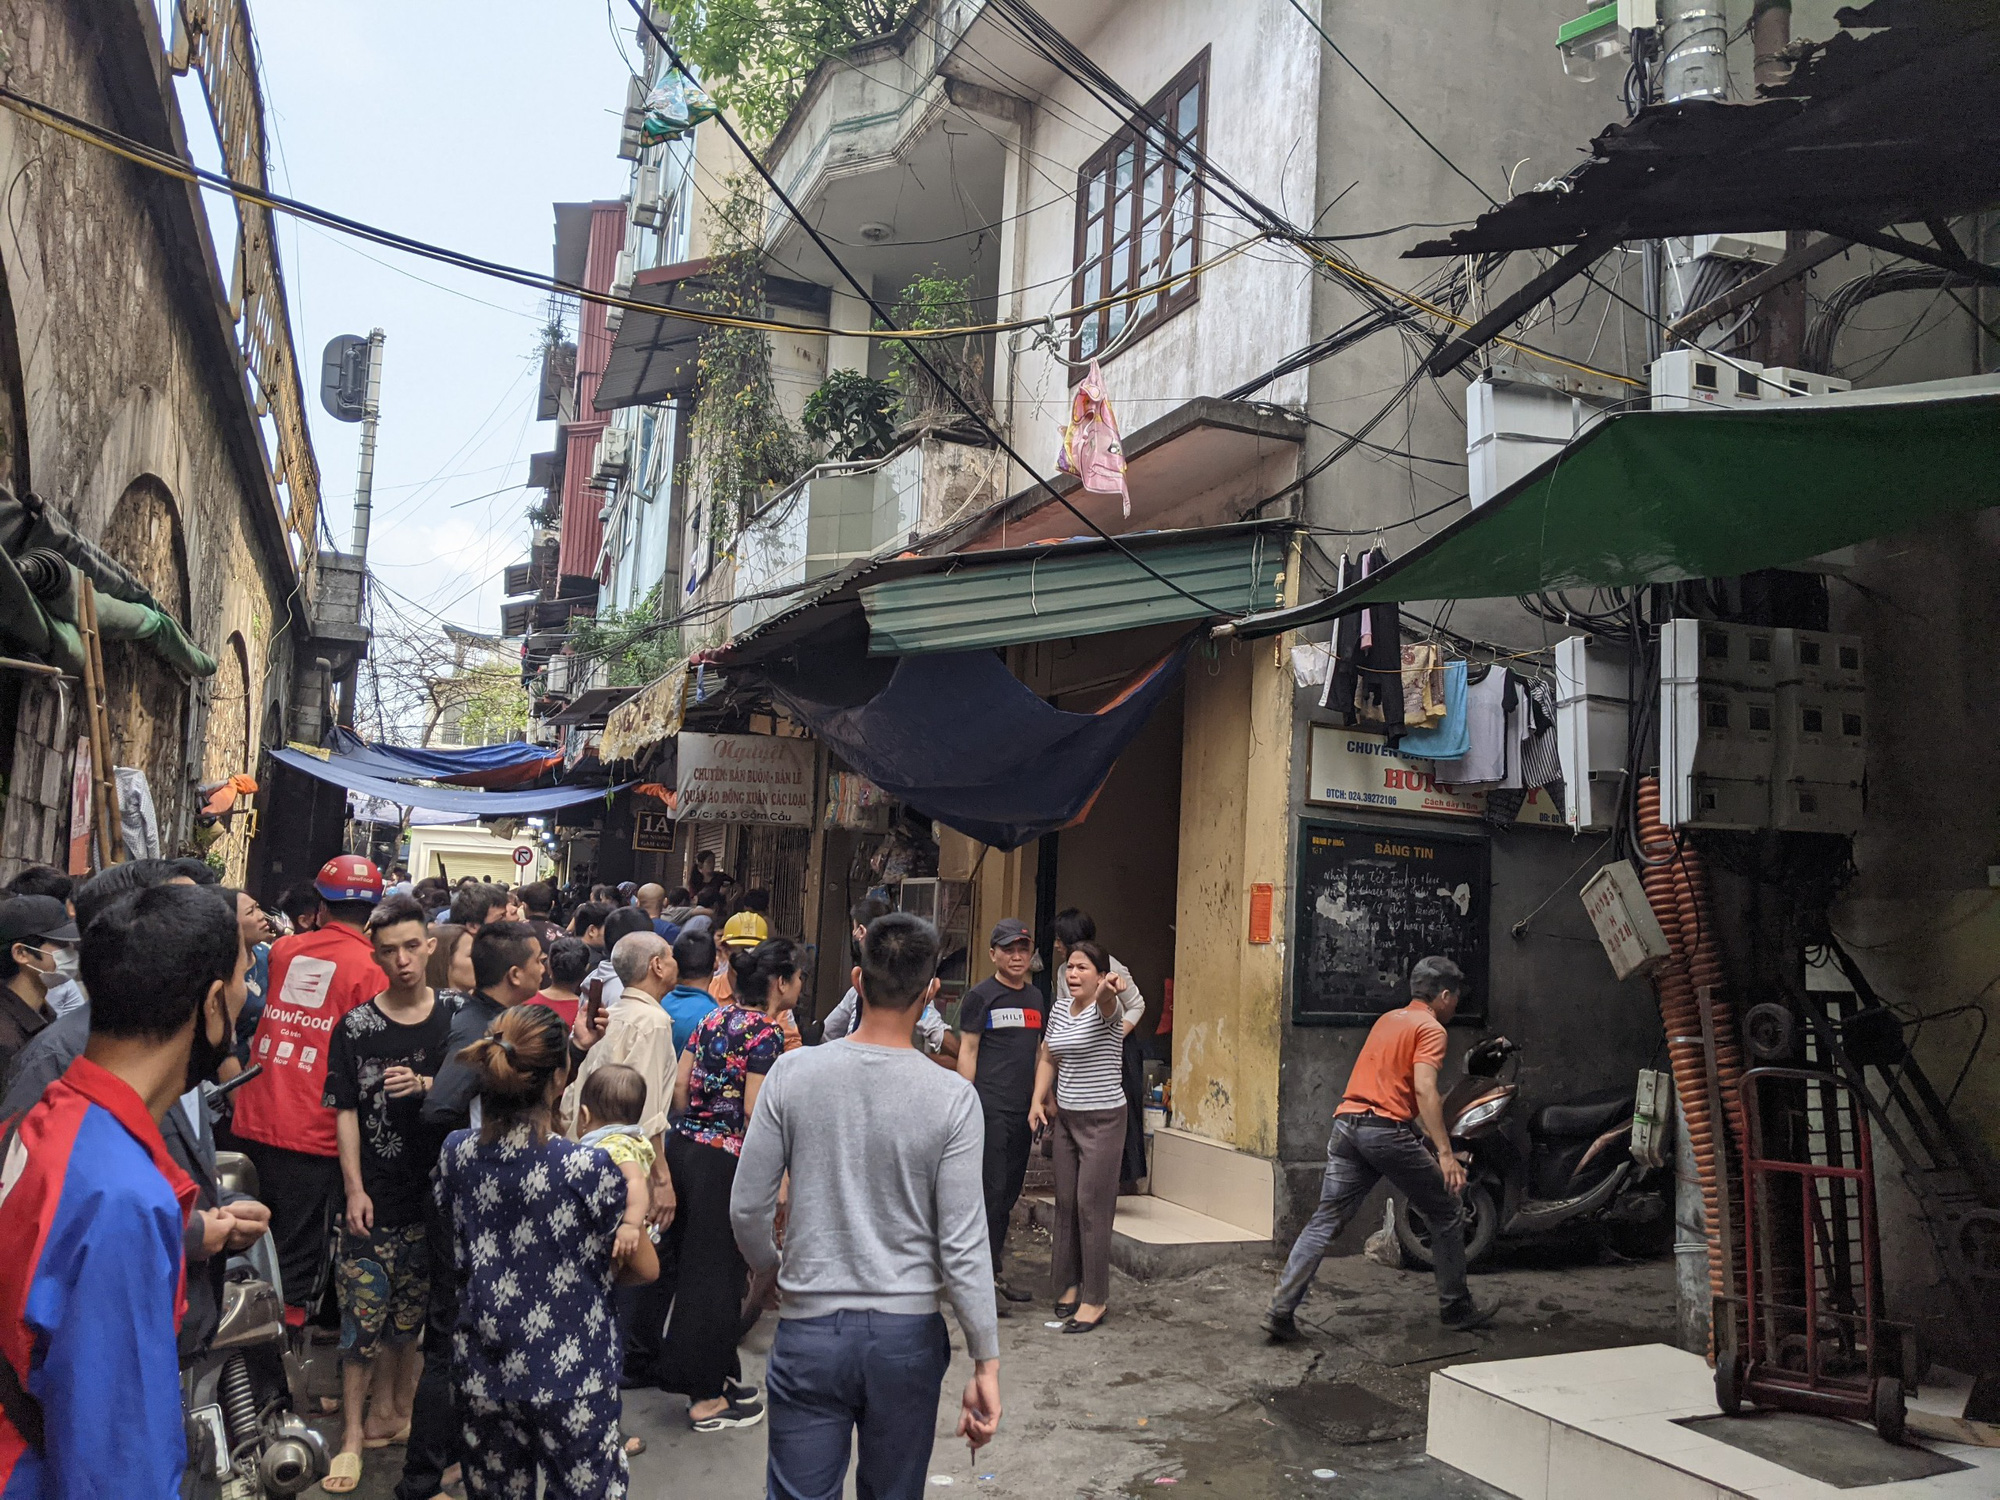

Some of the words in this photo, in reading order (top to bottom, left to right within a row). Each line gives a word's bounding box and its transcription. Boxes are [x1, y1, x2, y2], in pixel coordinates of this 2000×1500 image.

[1383, 765, 1460, 796] HÙN
[708, 787, 720, 804] ÁO
[771, 790, 788, 806] CÁC
[1348, 791, 1397, 806] 024.39272106
[643, 815, 670, 834] 1A
[730, 811, 737, 819] 3
[1374, 839, 1410, 857] BẢNG
[1413, 846, 1434, 860] TIN
[263, 1003, 334, 1032] NowFood
